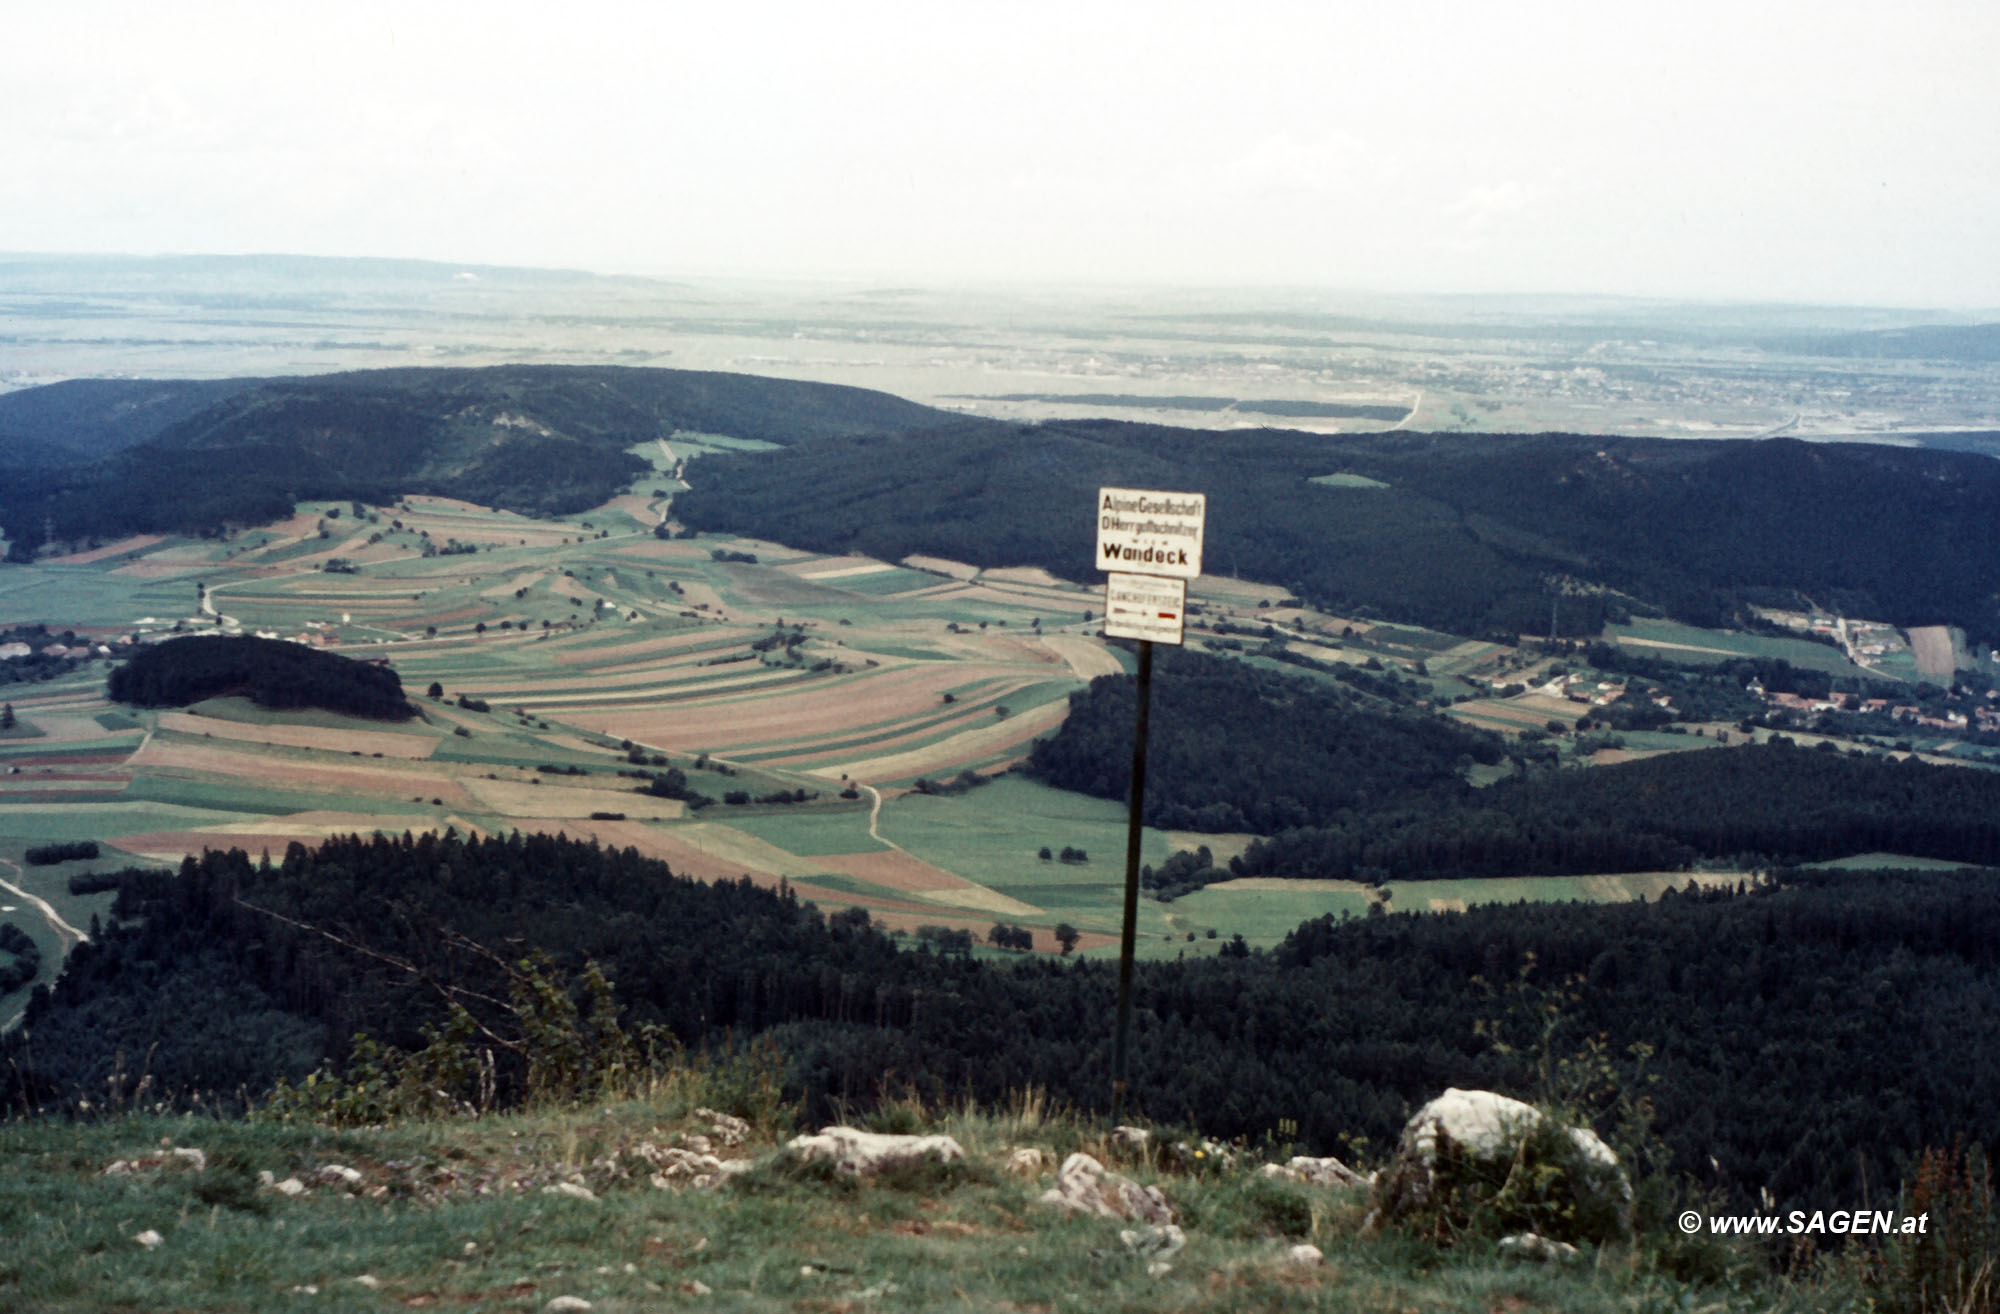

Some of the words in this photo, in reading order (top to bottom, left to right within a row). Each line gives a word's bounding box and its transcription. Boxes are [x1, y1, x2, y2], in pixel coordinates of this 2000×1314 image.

[1103, 494, 1138, 513] Alpine
[1138, 496, 1201, 517] Gesellschaft
[1103, 542, 1188, 566] Wandeck
